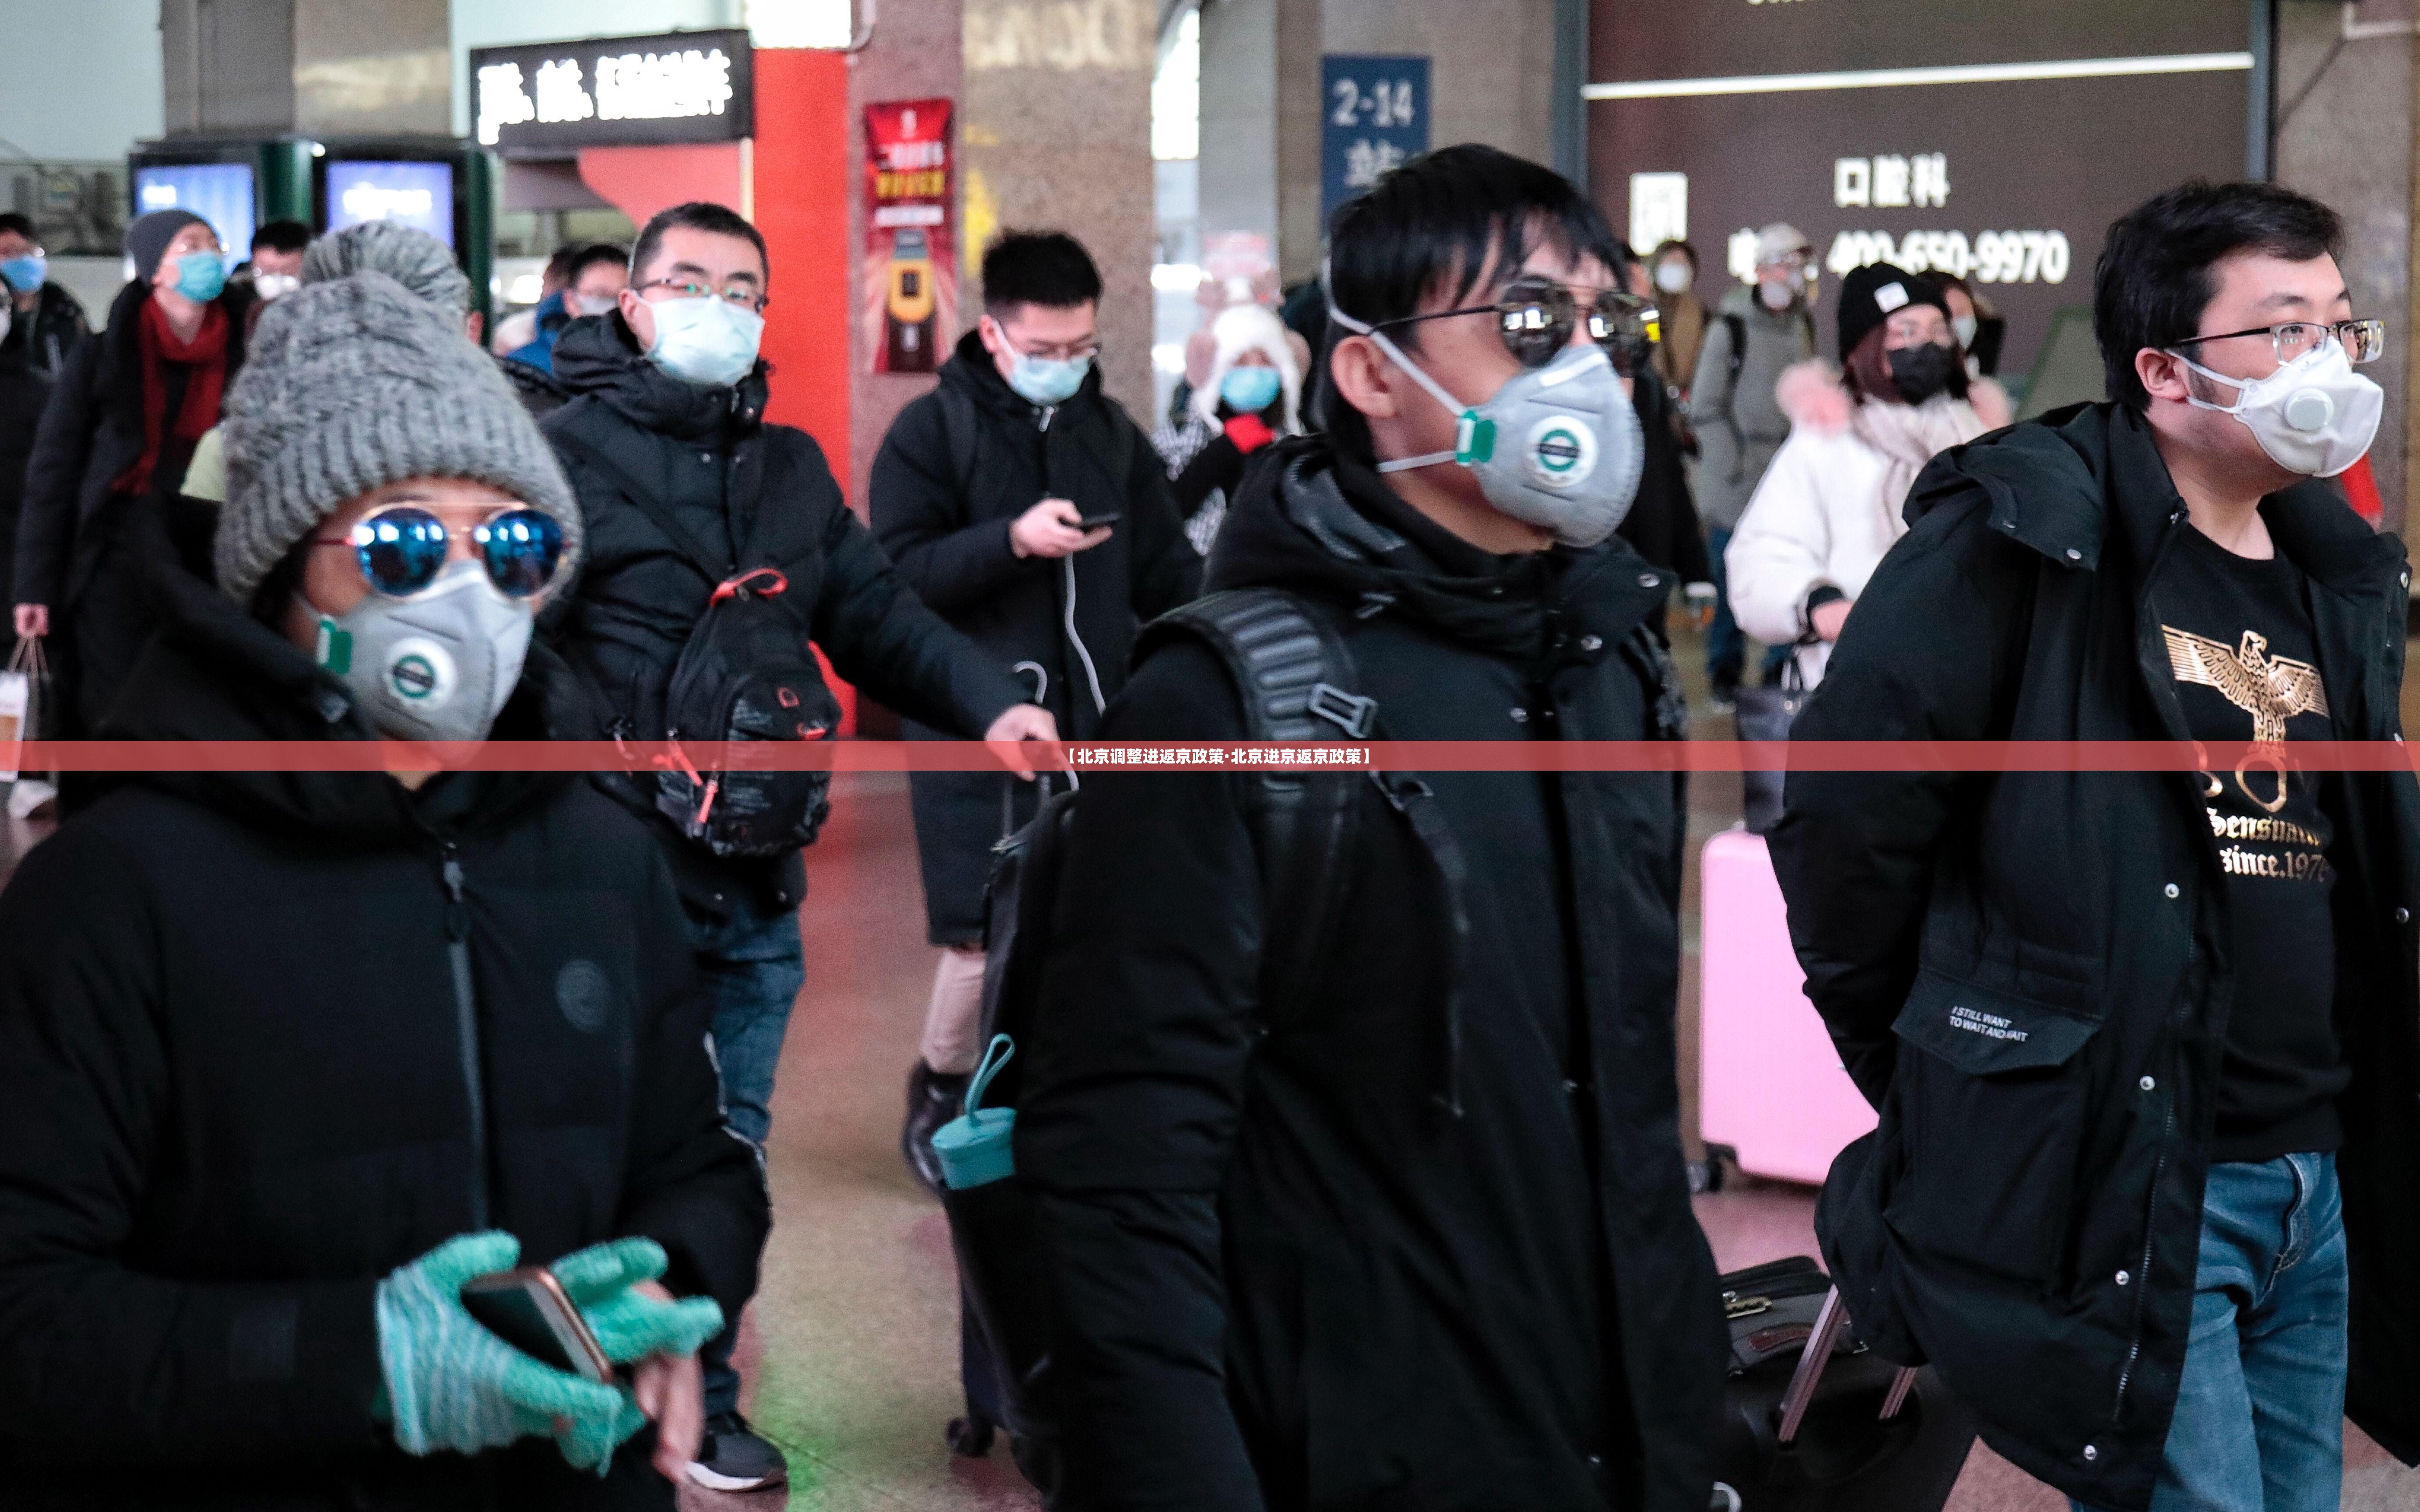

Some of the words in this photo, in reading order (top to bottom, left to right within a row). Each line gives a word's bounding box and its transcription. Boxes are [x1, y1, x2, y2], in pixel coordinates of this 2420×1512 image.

[1331, 77, 1415, 128] 2-14
[1825, 229, 2070, 284] 400-650-9970
[1950, 1015, 1963, 1028] TO
[1963, 1019, 1988, 1034] WAIT
[1985, 1027, 2007, 1039] AND
[1951, 1006, 1958, 1015] I
[1956, 1007, 1982, 1021] STILL
[1982, 1013, 2012, 1029] WANT
